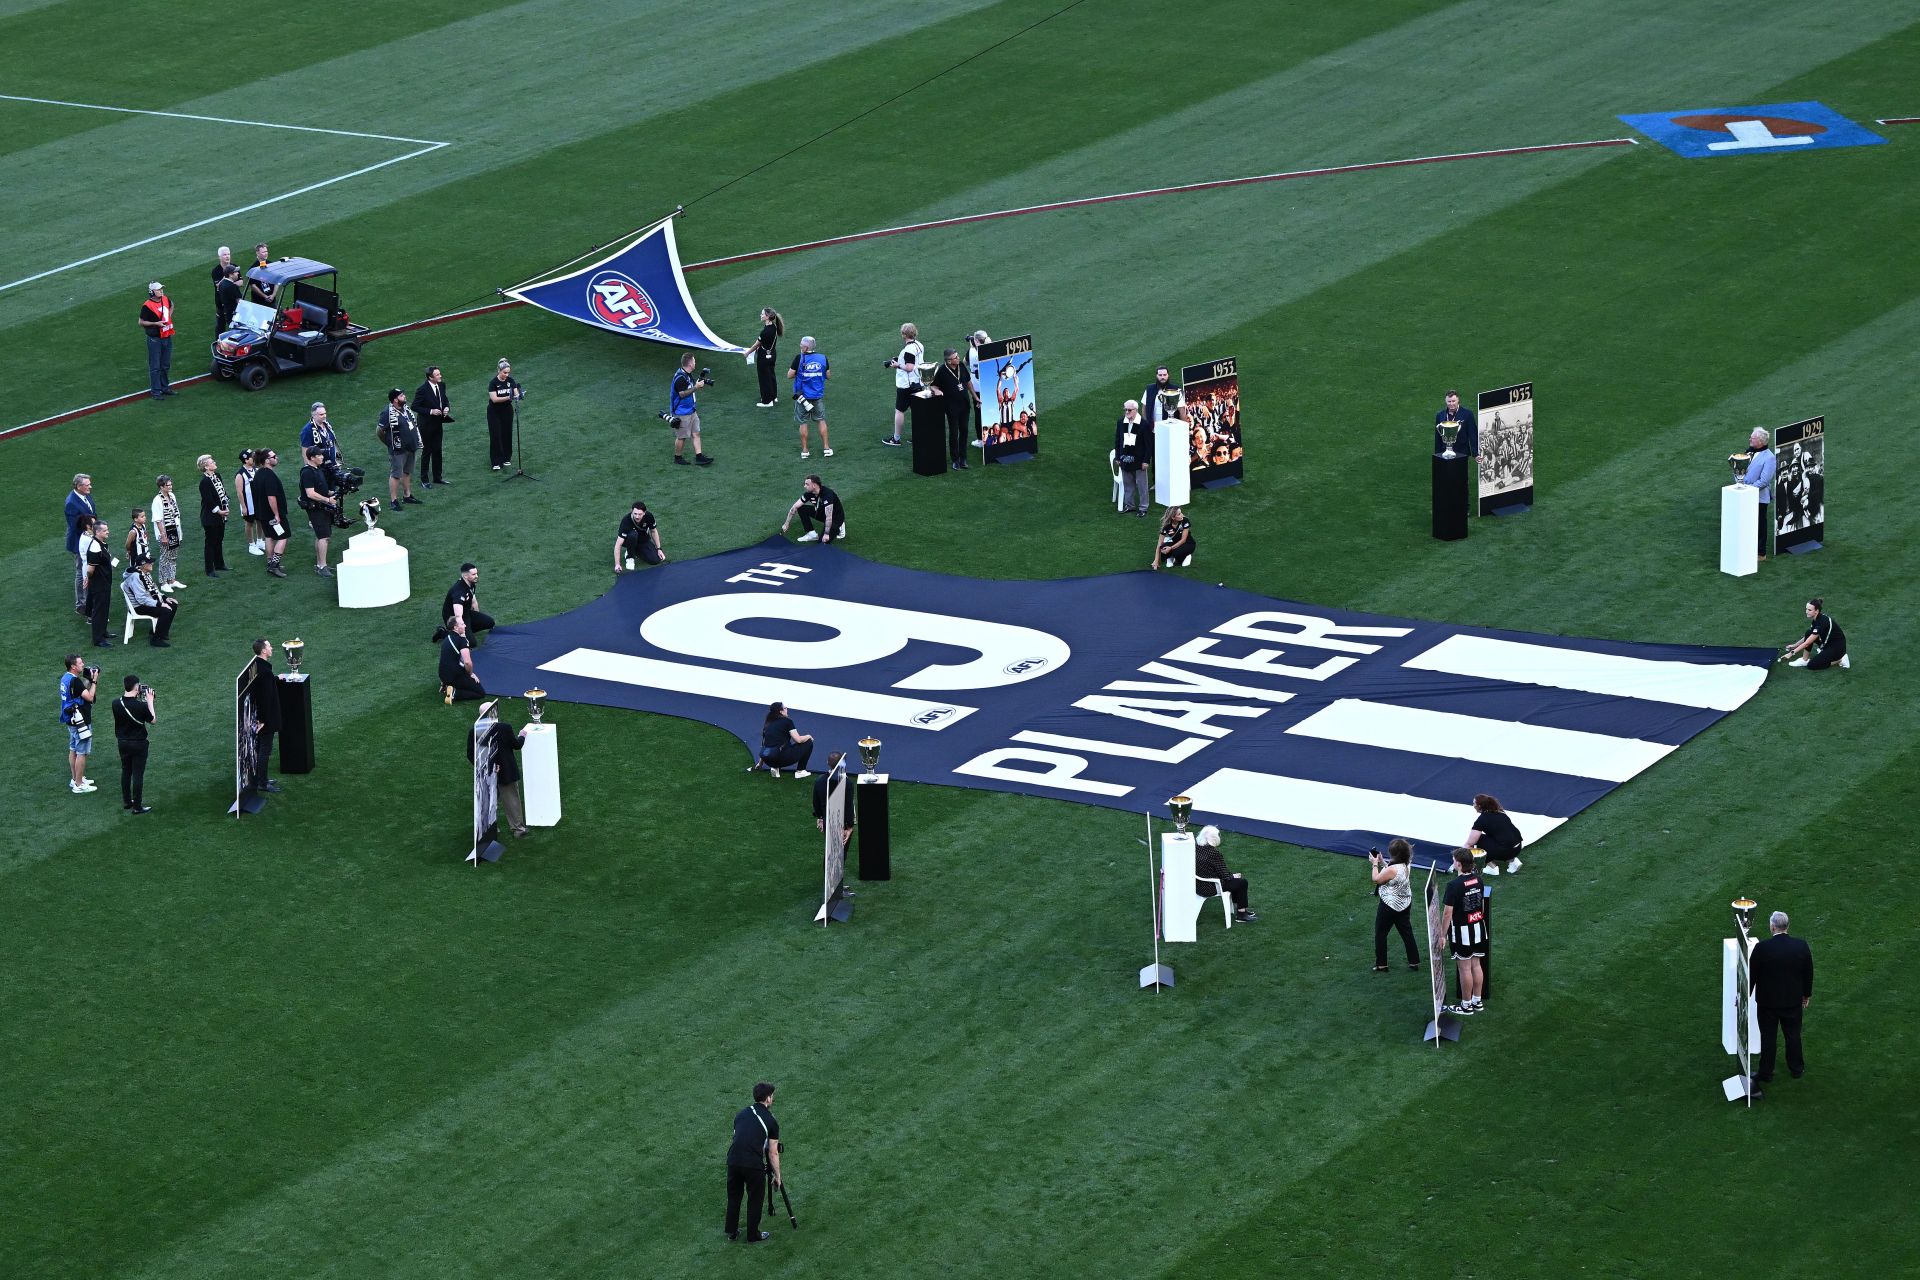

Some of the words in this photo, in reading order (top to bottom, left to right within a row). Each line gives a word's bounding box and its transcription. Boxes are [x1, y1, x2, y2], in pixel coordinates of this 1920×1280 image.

[592, 283, 651, 329] AFL
[1005, 338, 1029, 356] 1990
[1213, 360, 1235, 378] 1953
[1509, 386, 1531, 404] 1935
[1802, 420, 1822, 439] 1929
[1011, 658, 1044, 674] AFL
[952, 610, 1416, 797] PLAYER
[918, 707, 952, 725] AFL
[1469, 911, 1482, 923] KFC
